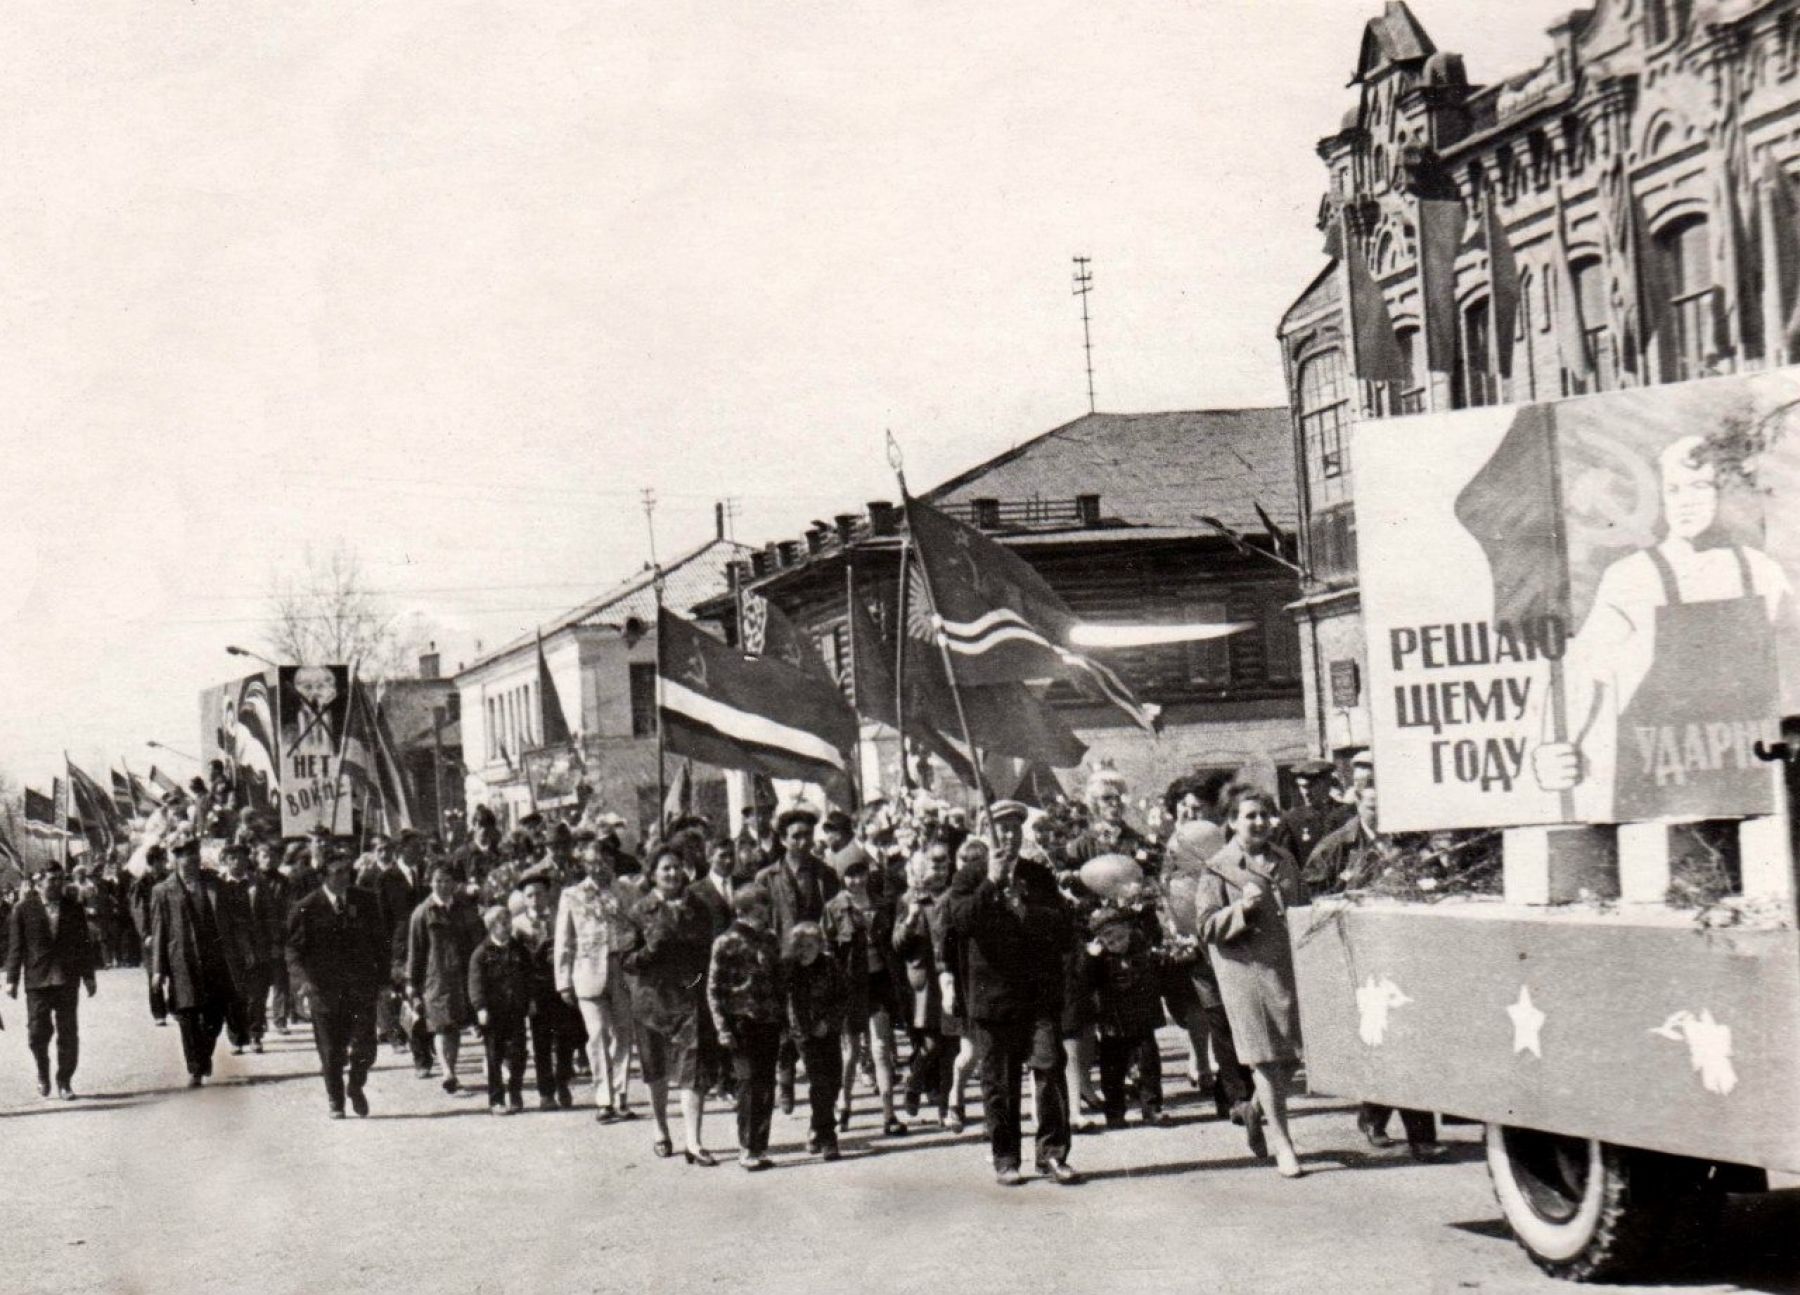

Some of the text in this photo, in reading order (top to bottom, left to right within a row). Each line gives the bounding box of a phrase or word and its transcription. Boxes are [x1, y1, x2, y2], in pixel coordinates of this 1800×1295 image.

[1389, 614, 1567, 671] РЕШАЮ
[1394, 676, 1531, 734] ЩЕМУ
[294, 754, 332, 778] НЕТ
[1430, 736, 1527, 792] ГОДУ
[1634, 721, 1780, 786] УДАРН
